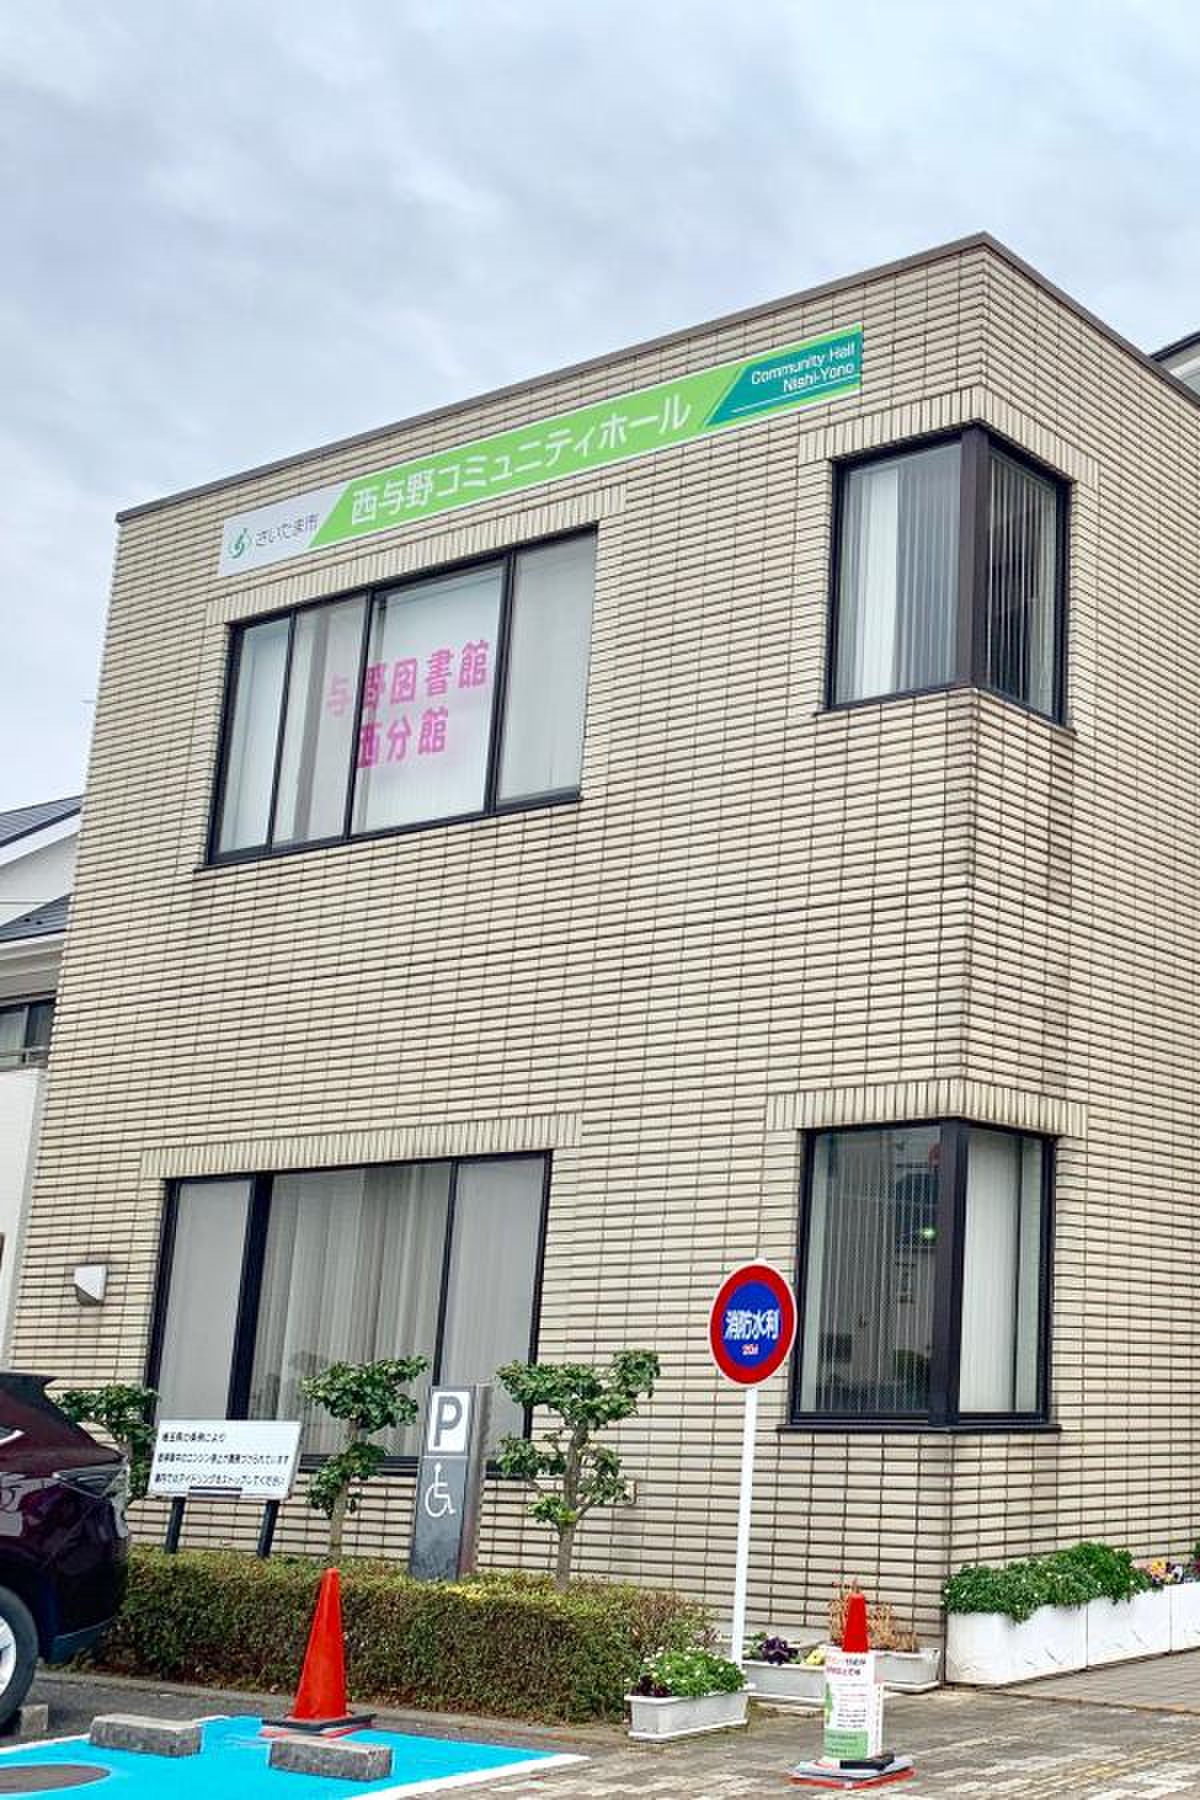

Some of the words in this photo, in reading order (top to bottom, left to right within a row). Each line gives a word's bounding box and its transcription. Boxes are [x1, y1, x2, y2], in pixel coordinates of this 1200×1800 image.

[752, 354, 825, 385] Community
[830, 341, 855, 363] Hall
[783, 363, 854, 392] Nishi-Yono
[352, 394, 691, 525] 西与野コミュニティホール
[255, 512, 319, 546] さいたま市
[725, 1309, 779, 1340] 消防水利
[433, 1396, 461, 1447] P
